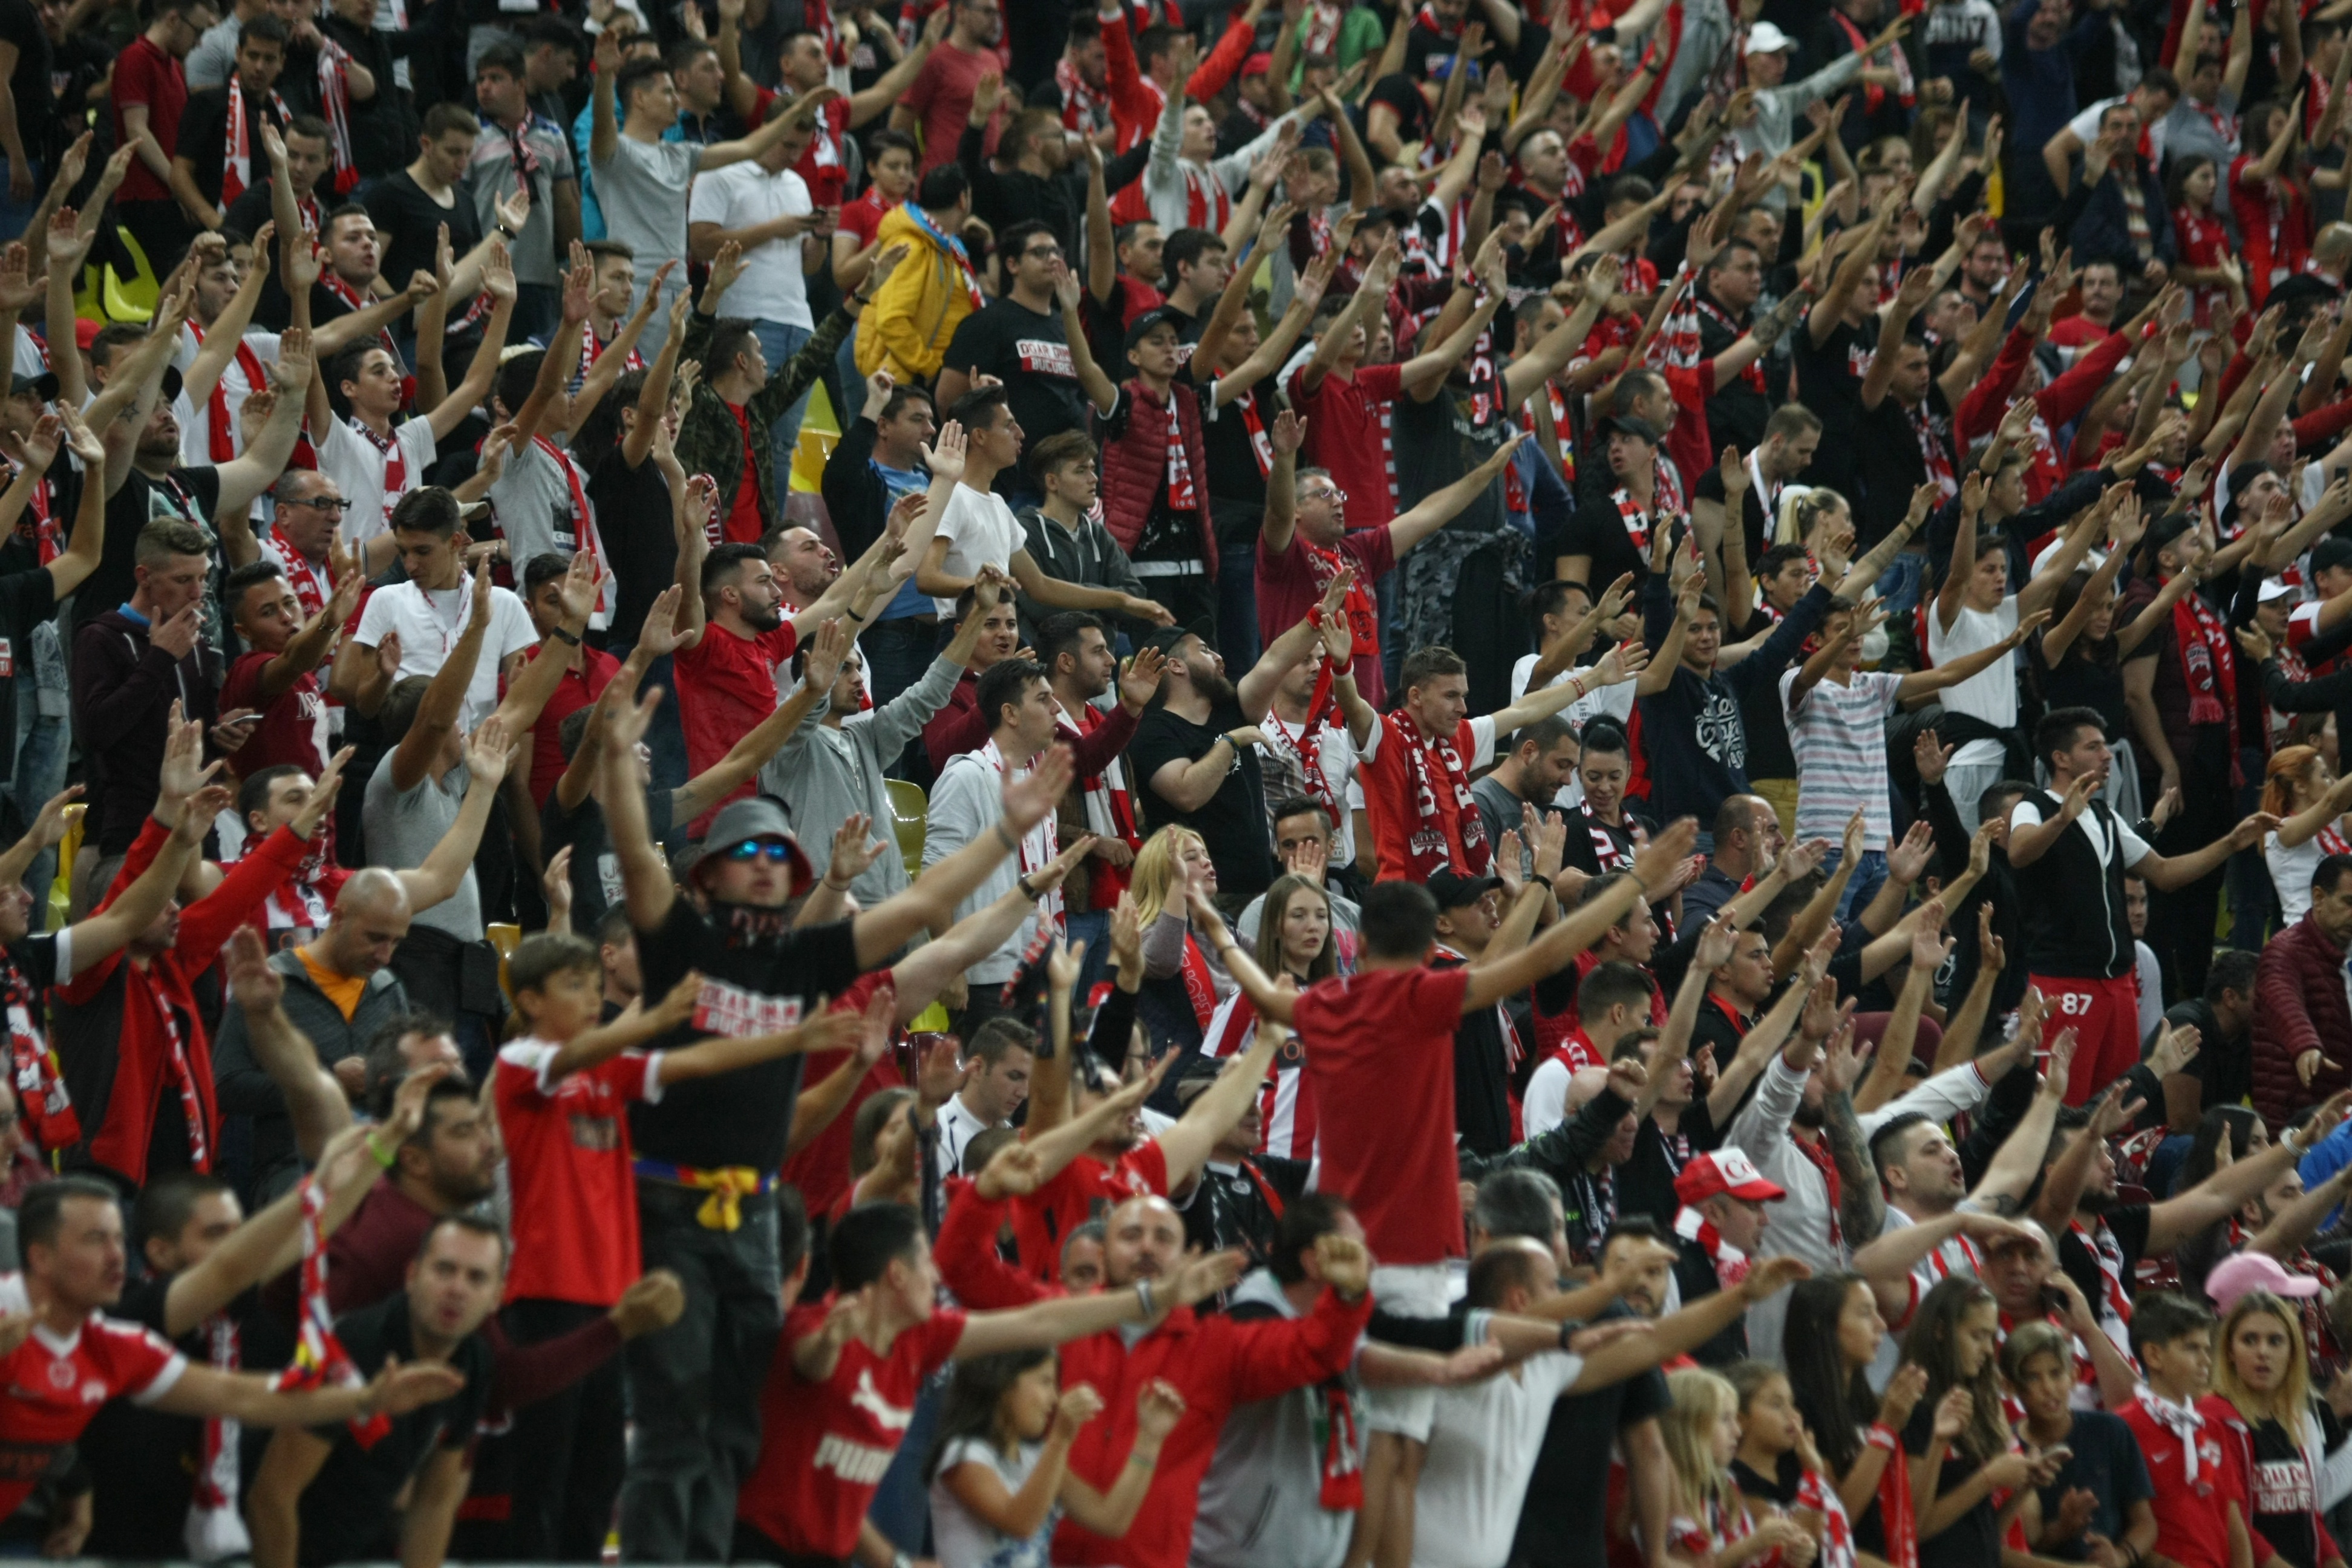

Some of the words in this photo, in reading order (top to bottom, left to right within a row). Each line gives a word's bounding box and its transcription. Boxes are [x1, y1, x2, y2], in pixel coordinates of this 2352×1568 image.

[1019, 342, 1048, 357] DOAR
[1051, 346, 1071, 362] DIN
[1031, 358, 1077, 378] BUCURE
[2062, 993, 2092, 1016] 87
[813, 1433, 894, 1485] PUM
